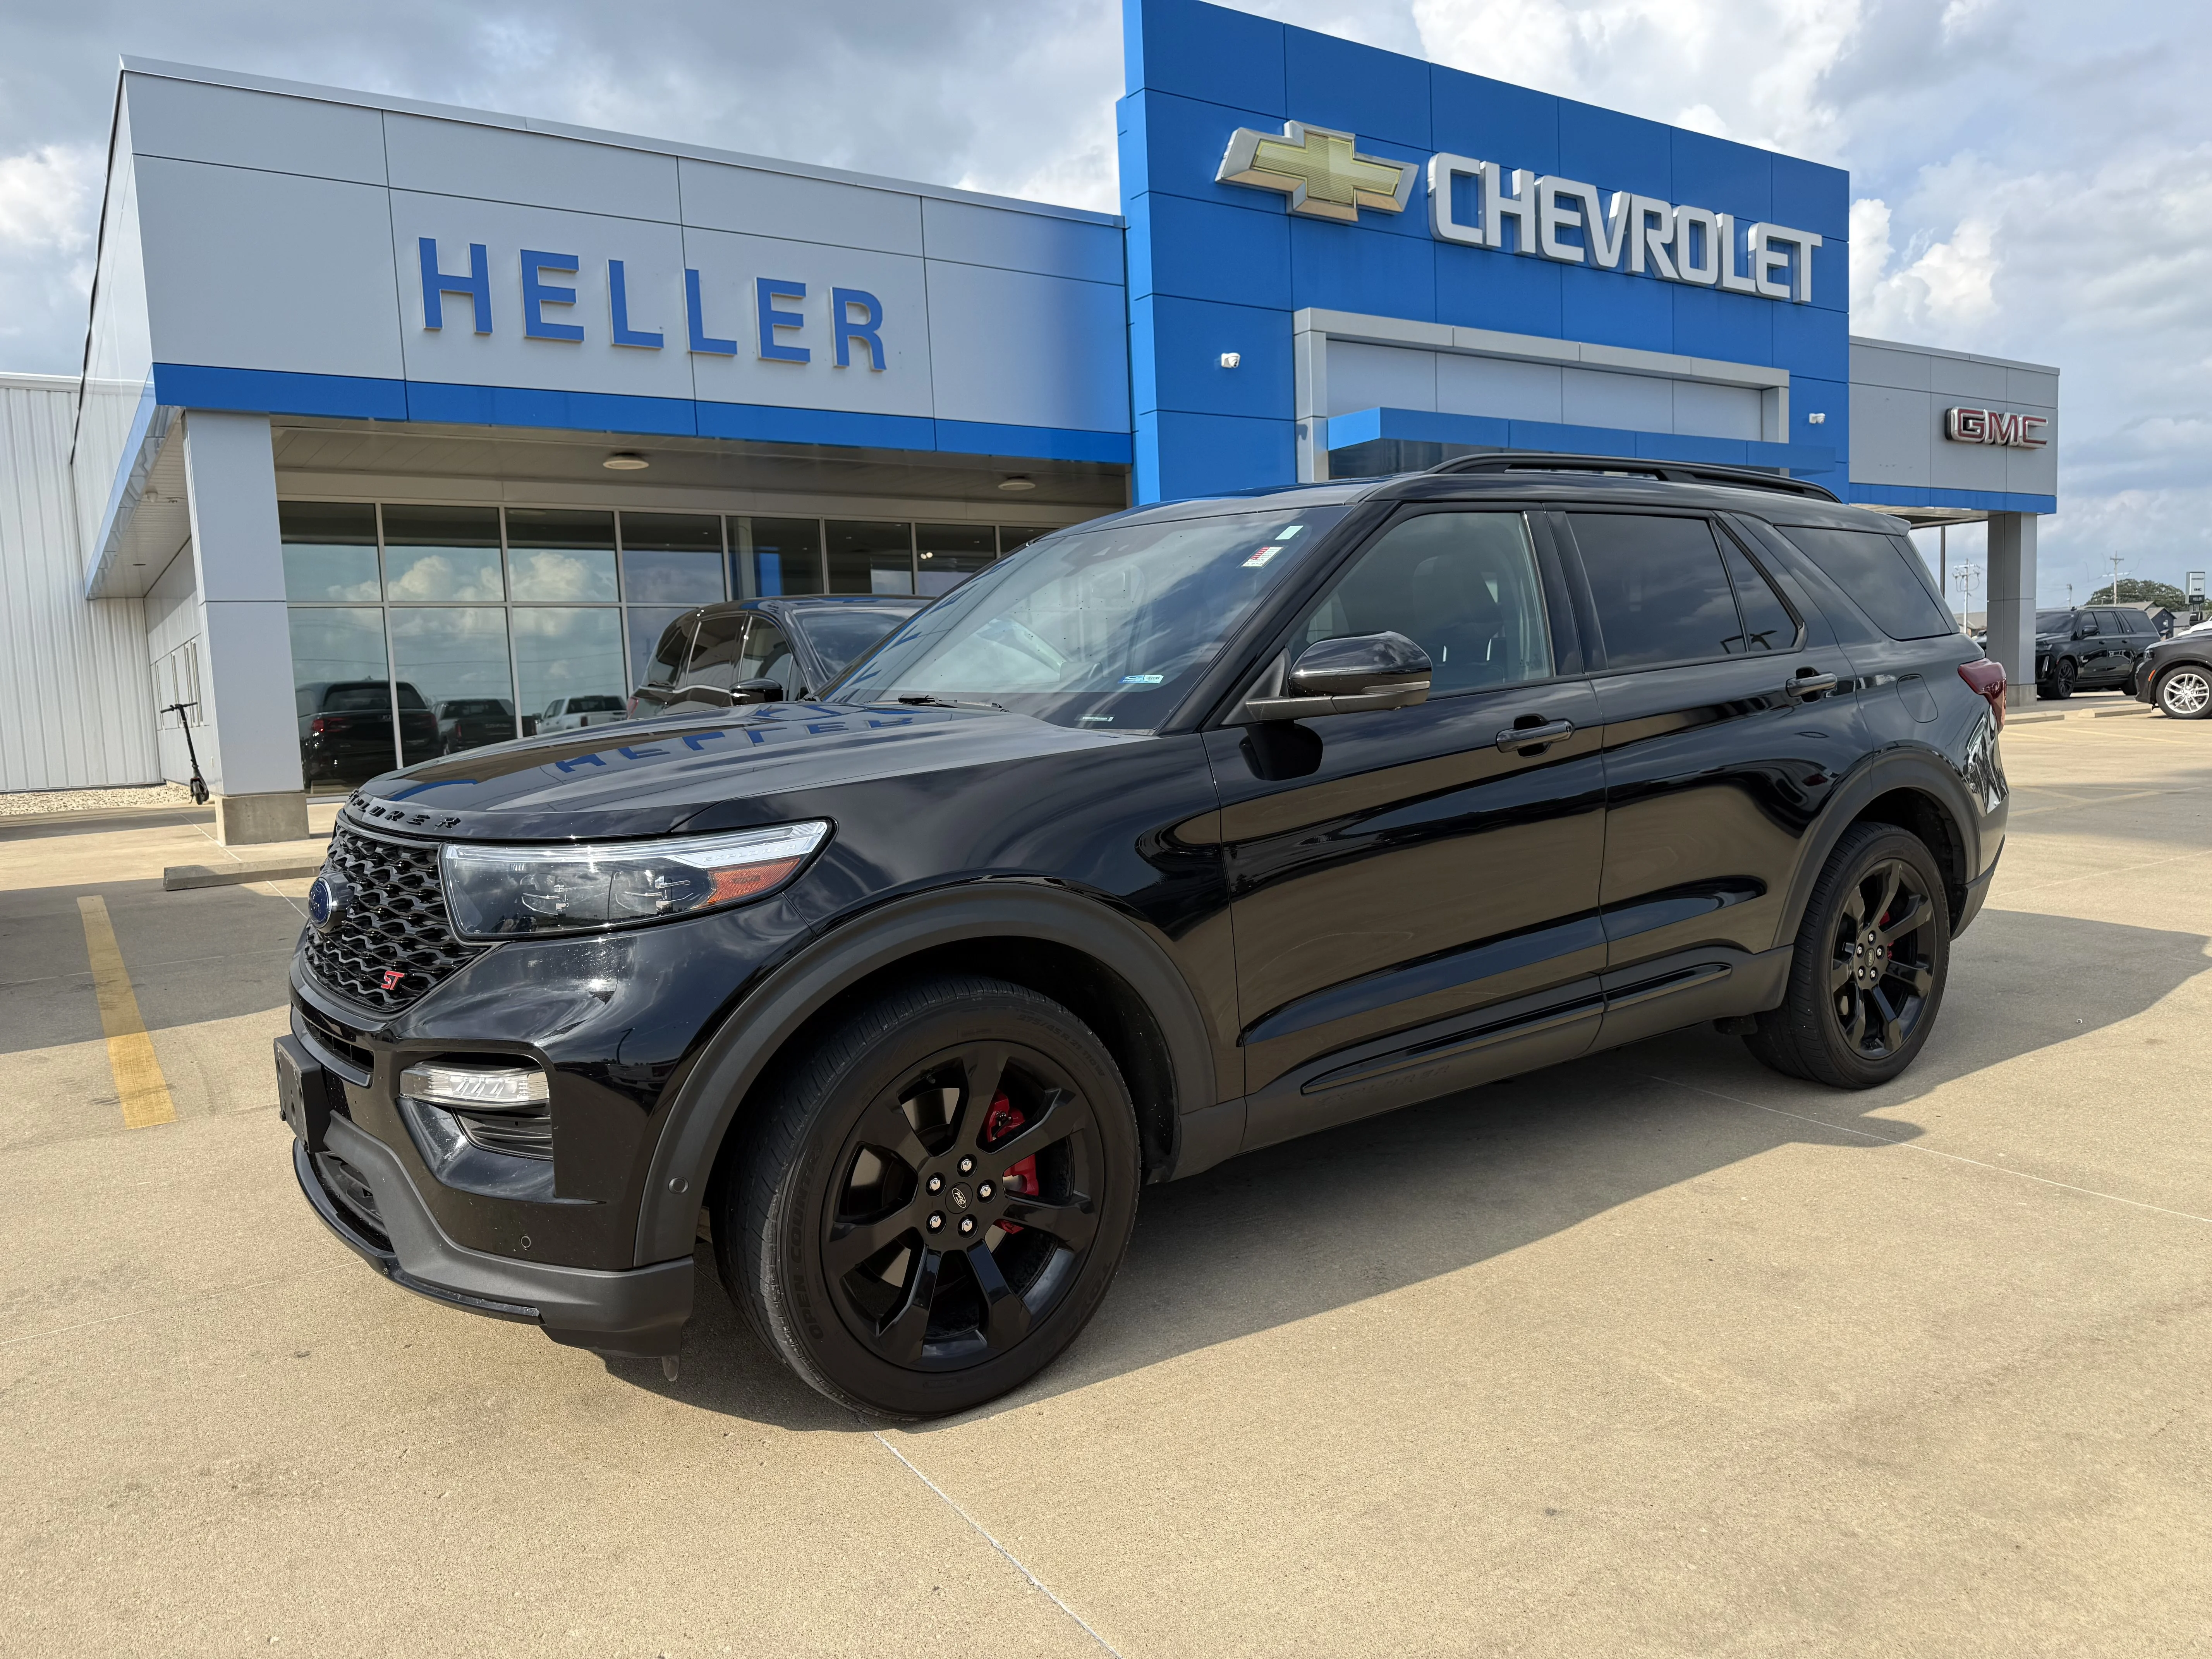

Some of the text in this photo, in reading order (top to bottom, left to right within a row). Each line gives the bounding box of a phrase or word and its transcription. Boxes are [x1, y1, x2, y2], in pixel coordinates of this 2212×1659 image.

[1427, 152, 1822, 303] CHEVROLET
[418, 237, 887, 372] HELLER
[1948, 406, 2048, 448] GMC
[702, 844, 796, 862] EXPLORER
[381, 970, 405, 990] ST
[790, 1133, 824, 1340] OPEN COUNTRY
